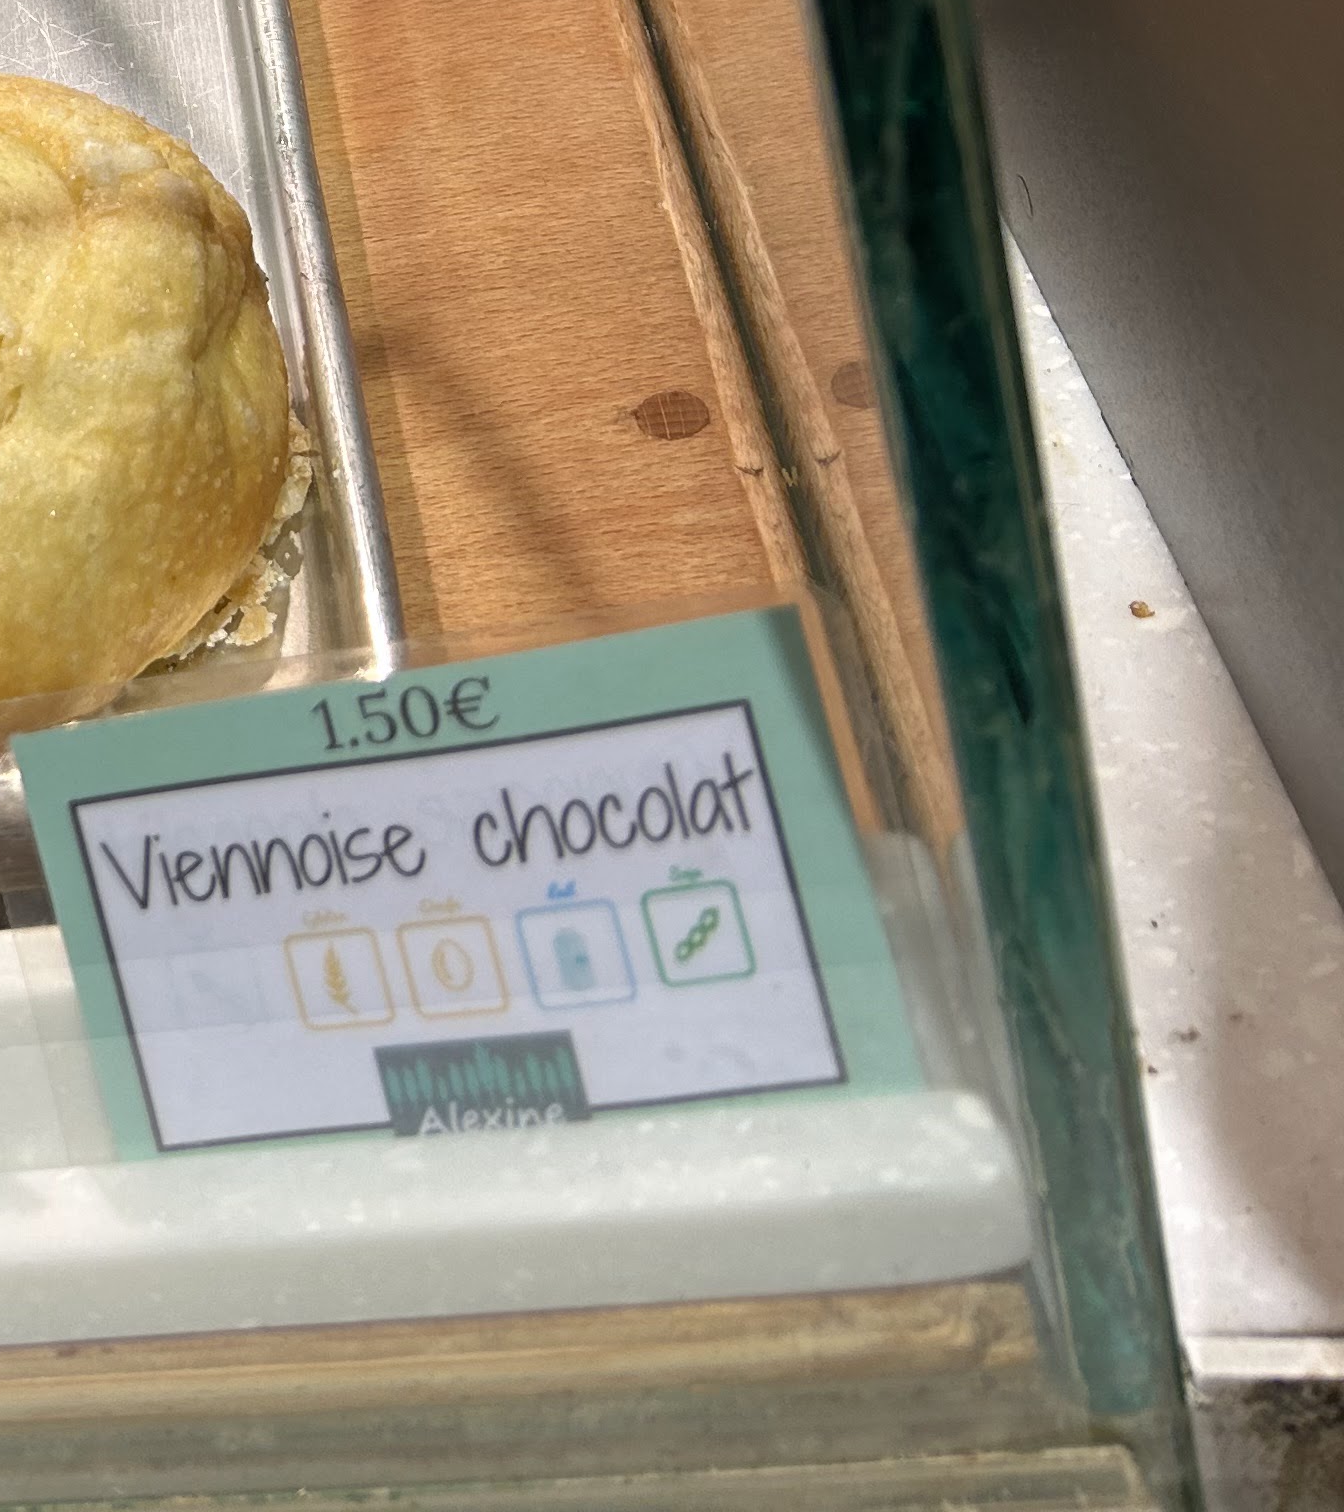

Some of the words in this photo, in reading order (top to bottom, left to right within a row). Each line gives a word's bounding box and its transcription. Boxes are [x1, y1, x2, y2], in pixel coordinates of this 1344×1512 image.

[310, 675, 500, 751] 1.50€
[99, 811, 428, 911] Viennoise
[473, 752, 756, 868] chocolat
[417, 1096, 564, 1136] Alexine
